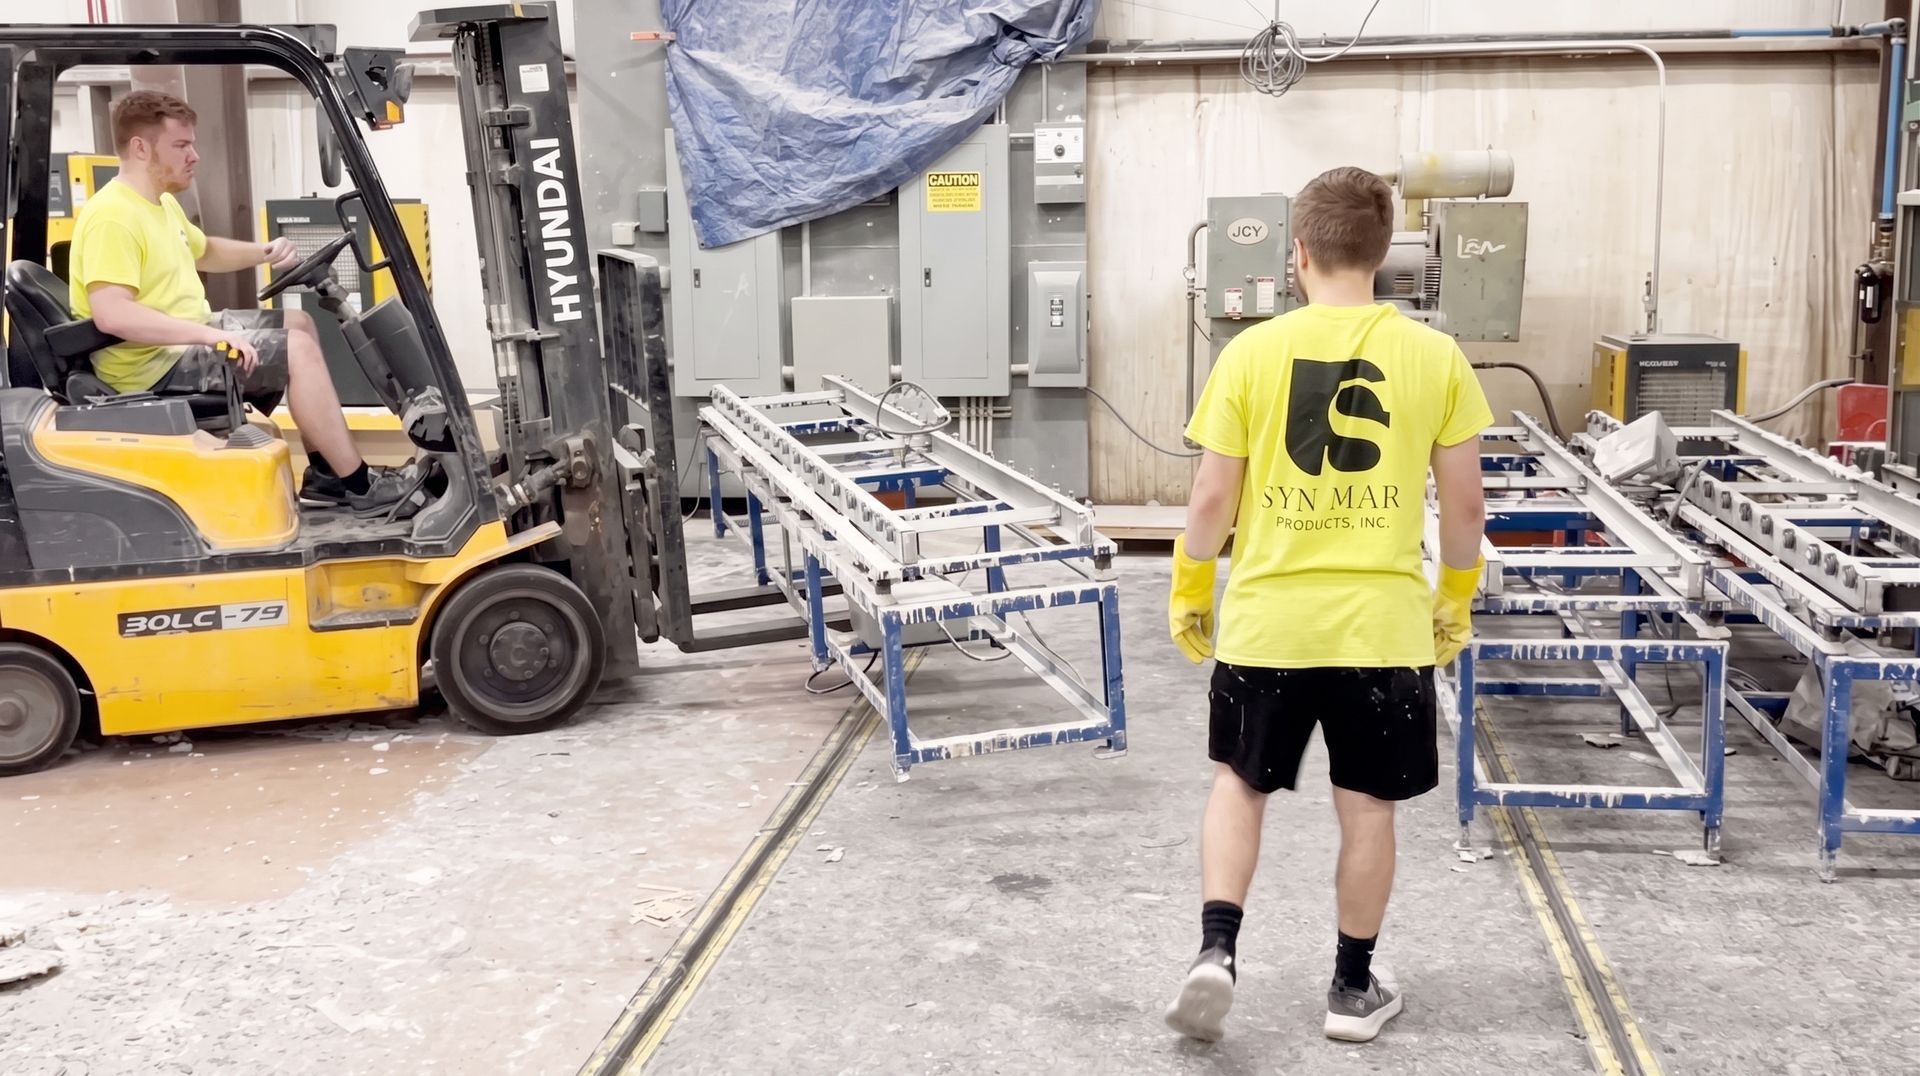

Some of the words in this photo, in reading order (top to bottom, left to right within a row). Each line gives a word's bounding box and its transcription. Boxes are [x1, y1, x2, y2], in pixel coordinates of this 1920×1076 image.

[929, 174, 978, 186] CAUTION
[529, 137, 584, 323] HYUNDAI
[1232, 225, 1263, 238] JCY
[1261, 485, 1318, 512] SYN
[1330, 484, 1401, 511] MAR
[1275, 516, 1355, 531] PRODUCTS,
[1360, 516, 1390, 529] INC.
